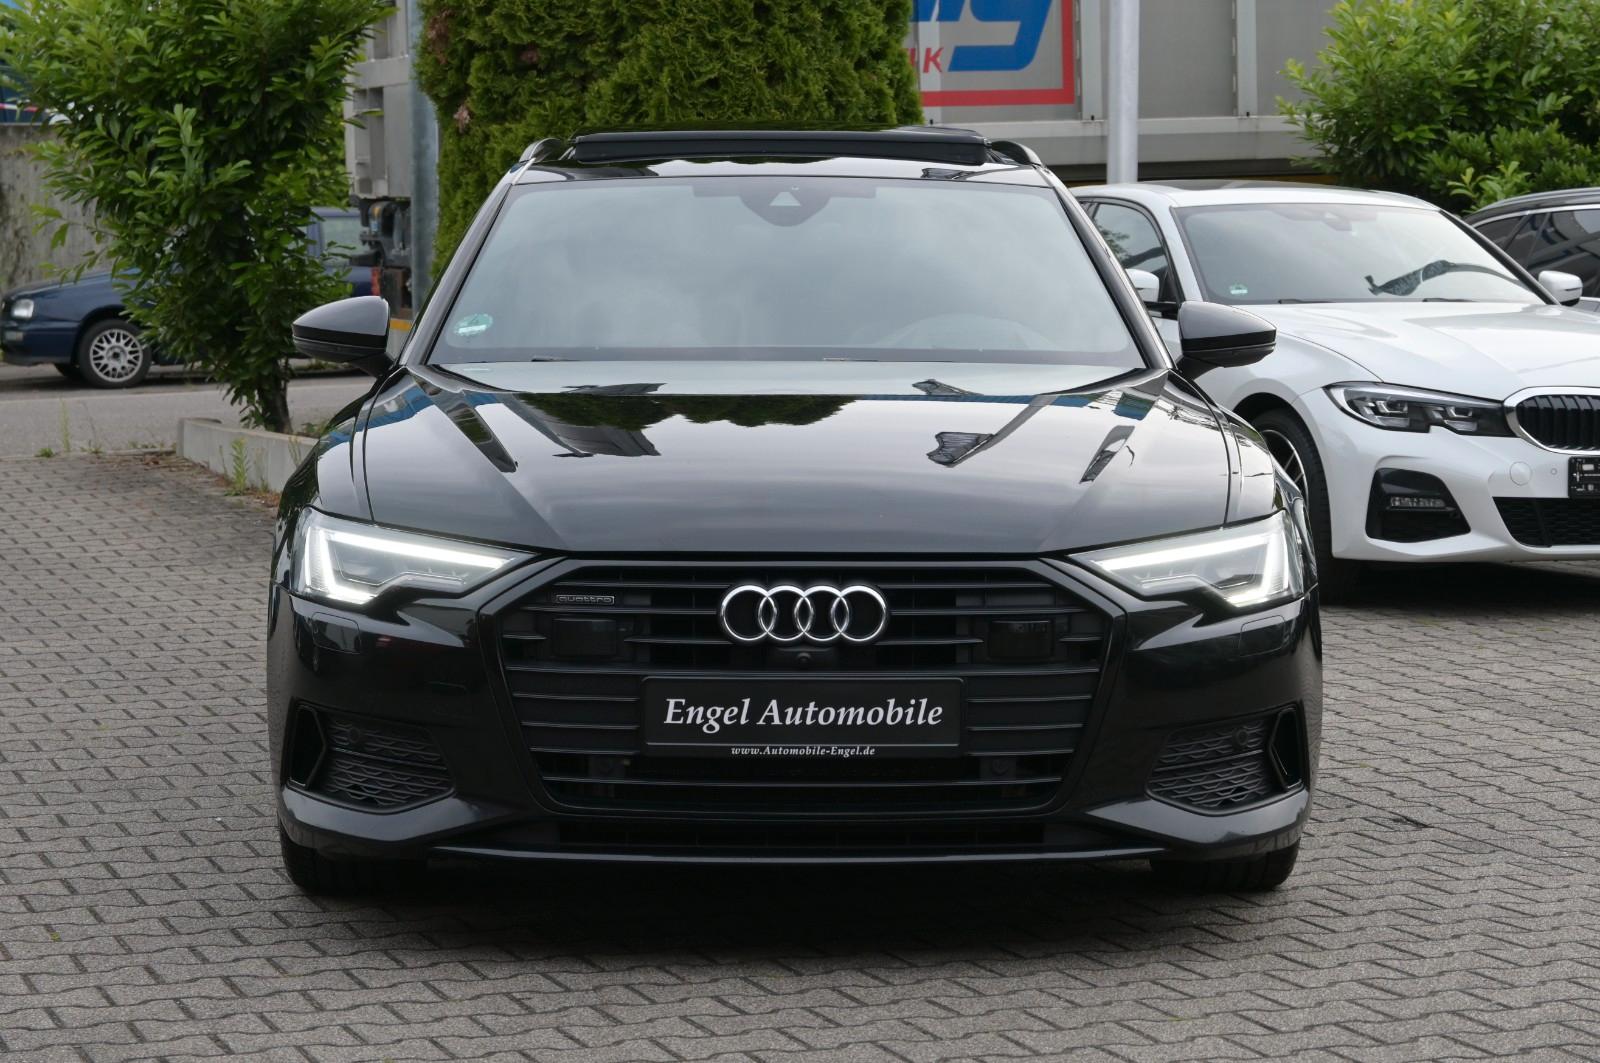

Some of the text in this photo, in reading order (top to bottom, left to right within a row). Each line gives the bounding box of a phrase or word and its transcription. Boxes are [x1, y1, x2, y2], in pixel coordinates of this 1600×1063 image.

[557, 595, 613, 604] quattro
[663, 697, 943, 734] Engel Automobile
[731, 746, 876, 757] www.Automobile-Engel.de
